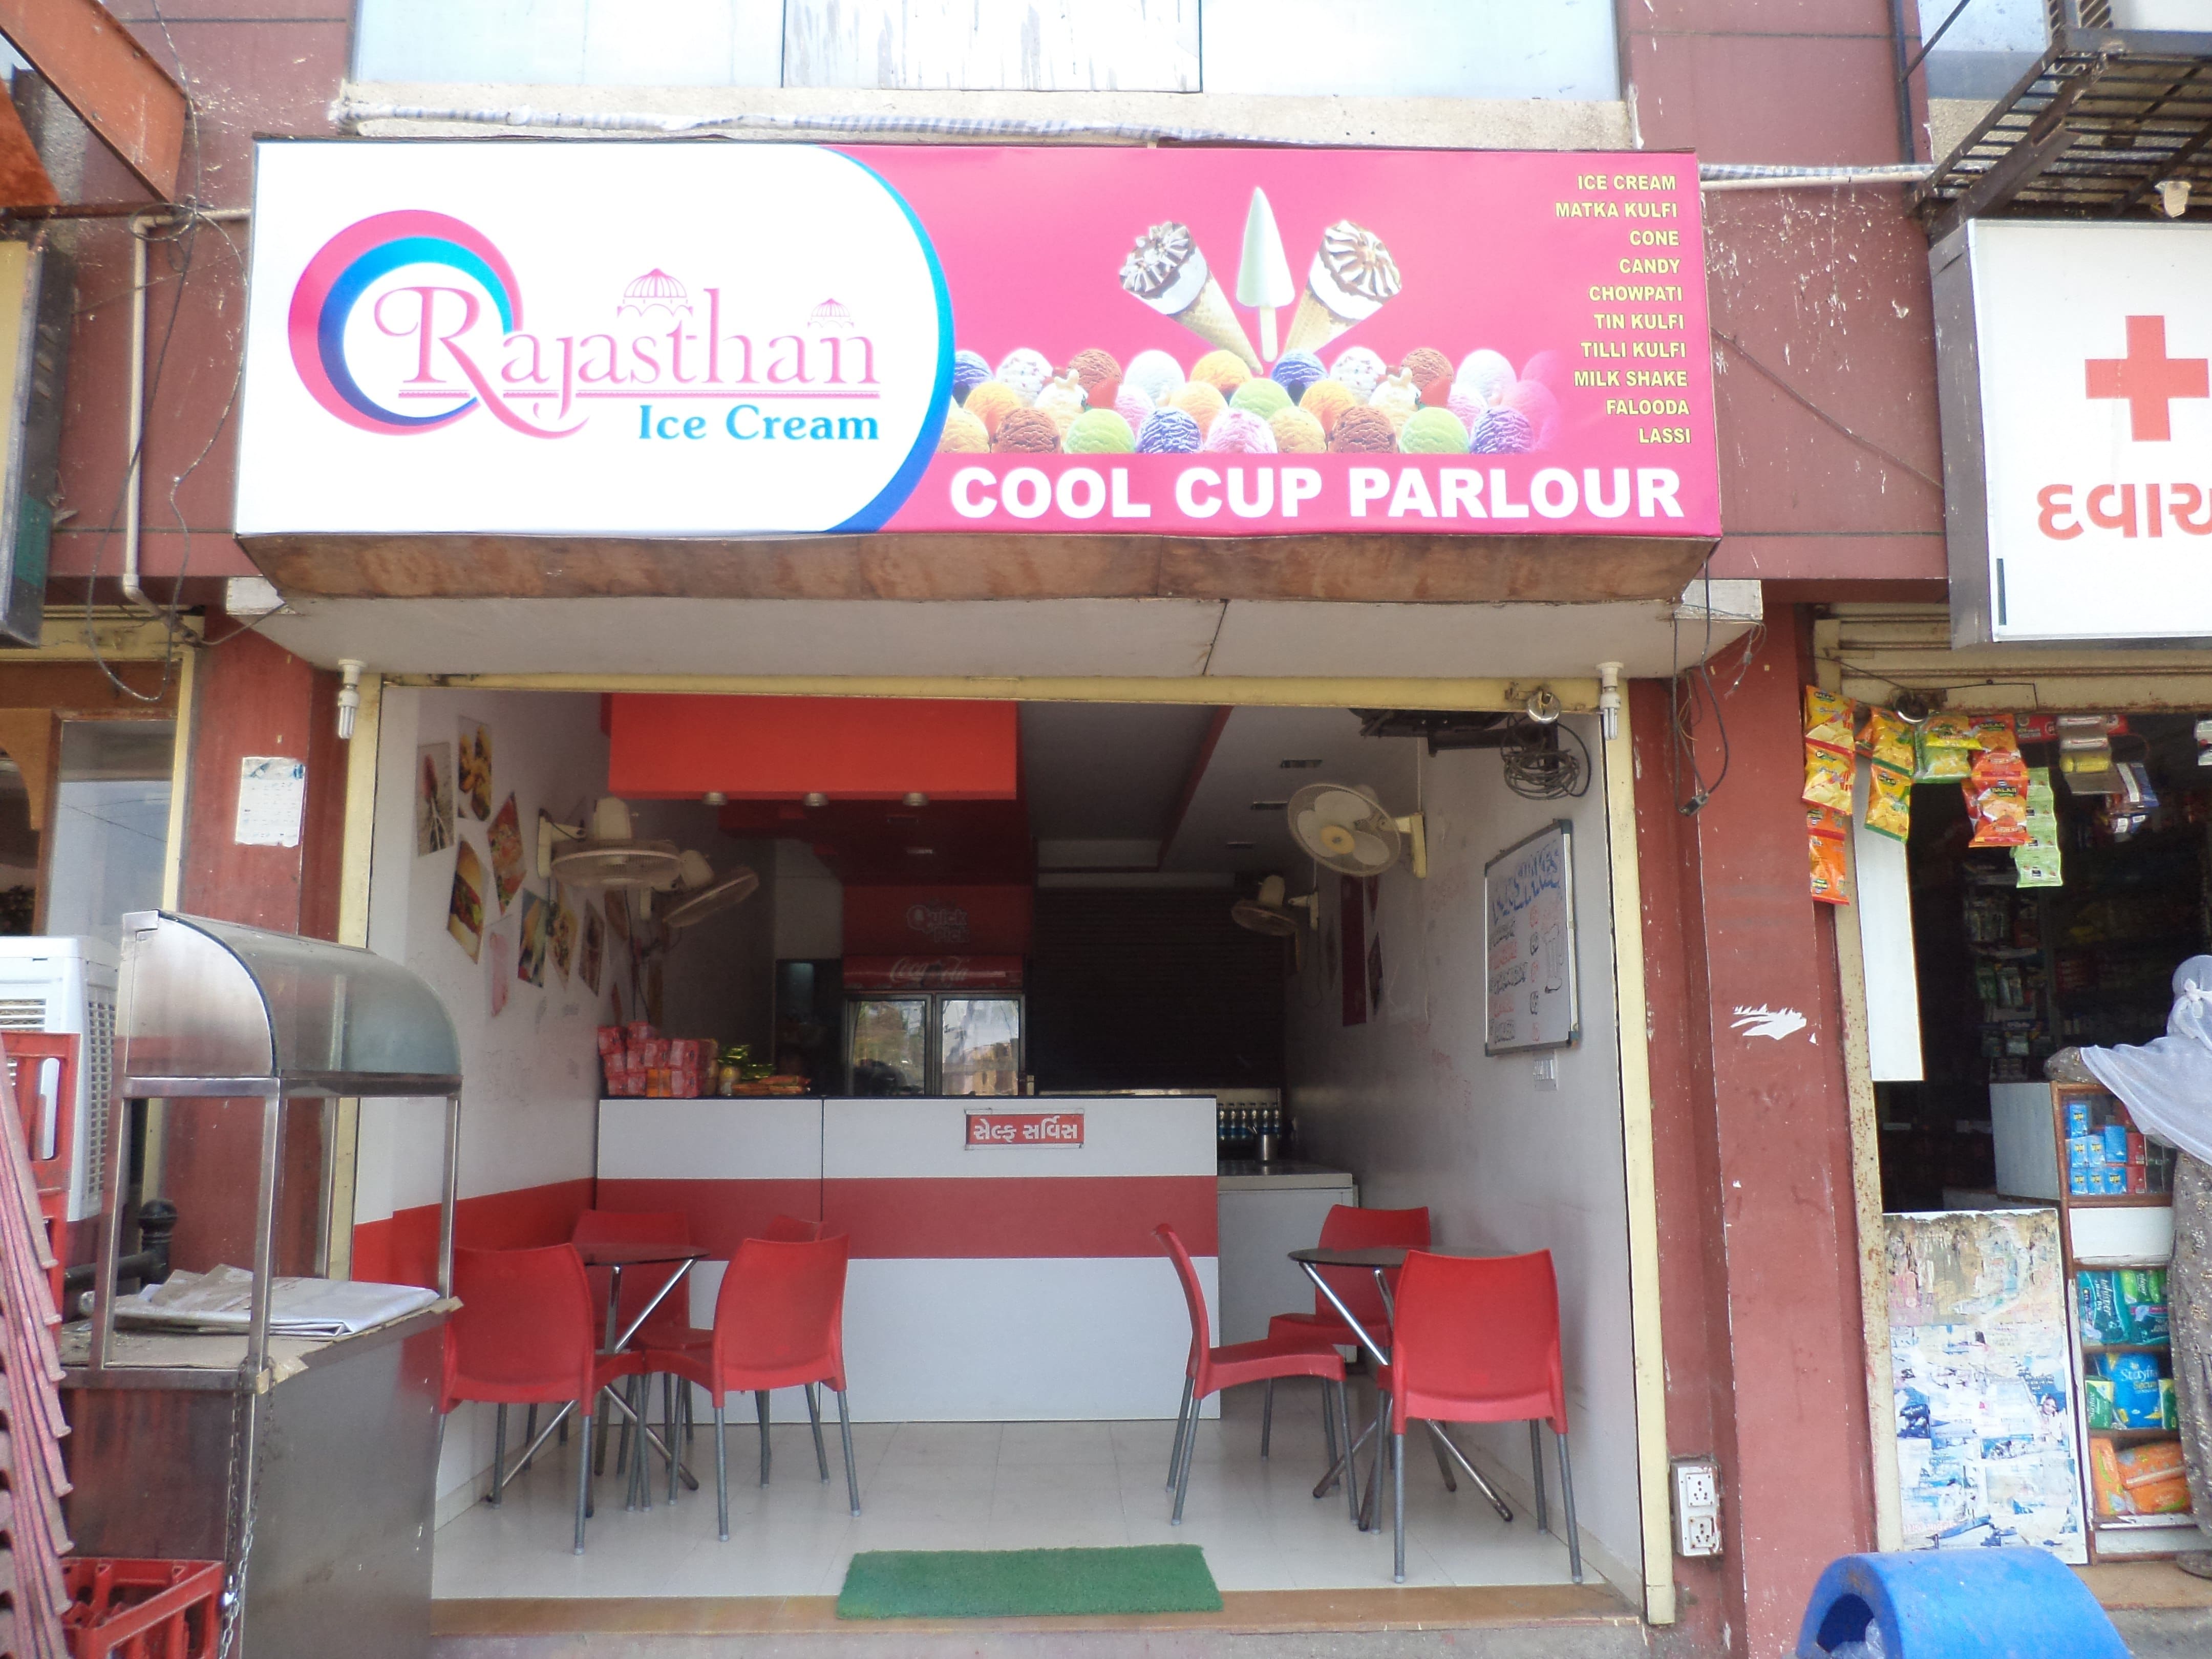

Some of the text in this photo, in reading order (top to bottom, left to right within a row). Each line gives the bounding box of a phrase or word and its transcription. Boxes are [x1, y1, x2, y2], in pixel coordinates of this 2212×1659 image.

[1577, 175, 1676, 190] ICE CREAM
[1555, 202, 1677, 218] MATKA KULFI
[1629, 230, 1679, 246] CONE
[1619, 259, 1681, 274] CANDY
[1589, 286, 1683, 301] CHOWPATI
[1593, 314, 1684, 329] TIN KULFI
[1580, 342, 1686, 358] TILLI KULFI
[373, 286, 881, 439] Rajasthan
[1573, 371, 1688, 387] MILK SHAKE
[1606, 399, 1690, 415] FALOODA
[639, 404, 880, 440] Ice Cream
[1639, 428, 1691, 443] LASSI
[950, 466, 1685, 519] COOL CUP PARLOUR
[889, 955, 971, 983] Cocaola
[973, 1115, 1077, 1142] સેલ્ફ સર્વિસ
